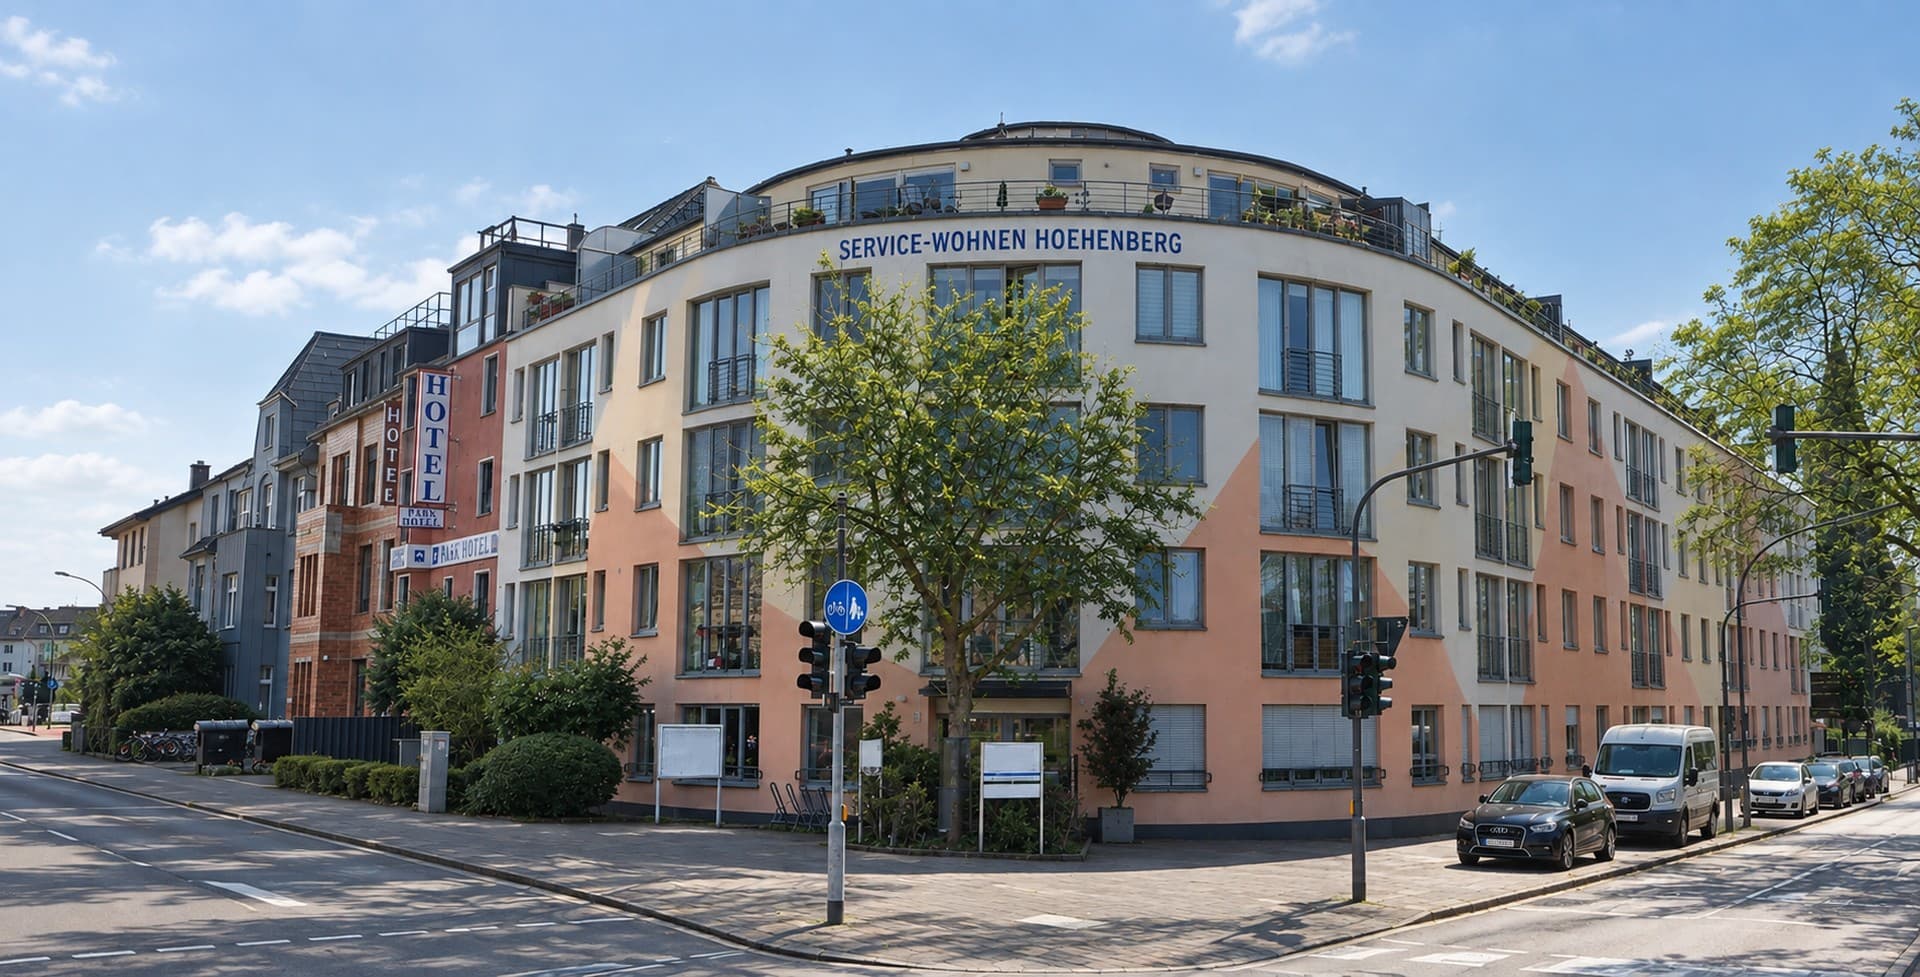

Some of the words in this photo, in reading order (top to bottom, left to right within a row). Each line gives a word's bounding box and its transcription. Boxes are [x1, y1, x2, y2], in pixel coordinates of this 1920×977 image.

[838, 229, 1026, 260] SERVICE-WOHNEN
[1036, 228, 1182, 254] HOEHENBERG
[422, 374, 448, 502] HOTEL
[462, 536, 489, 559] HOTEL
